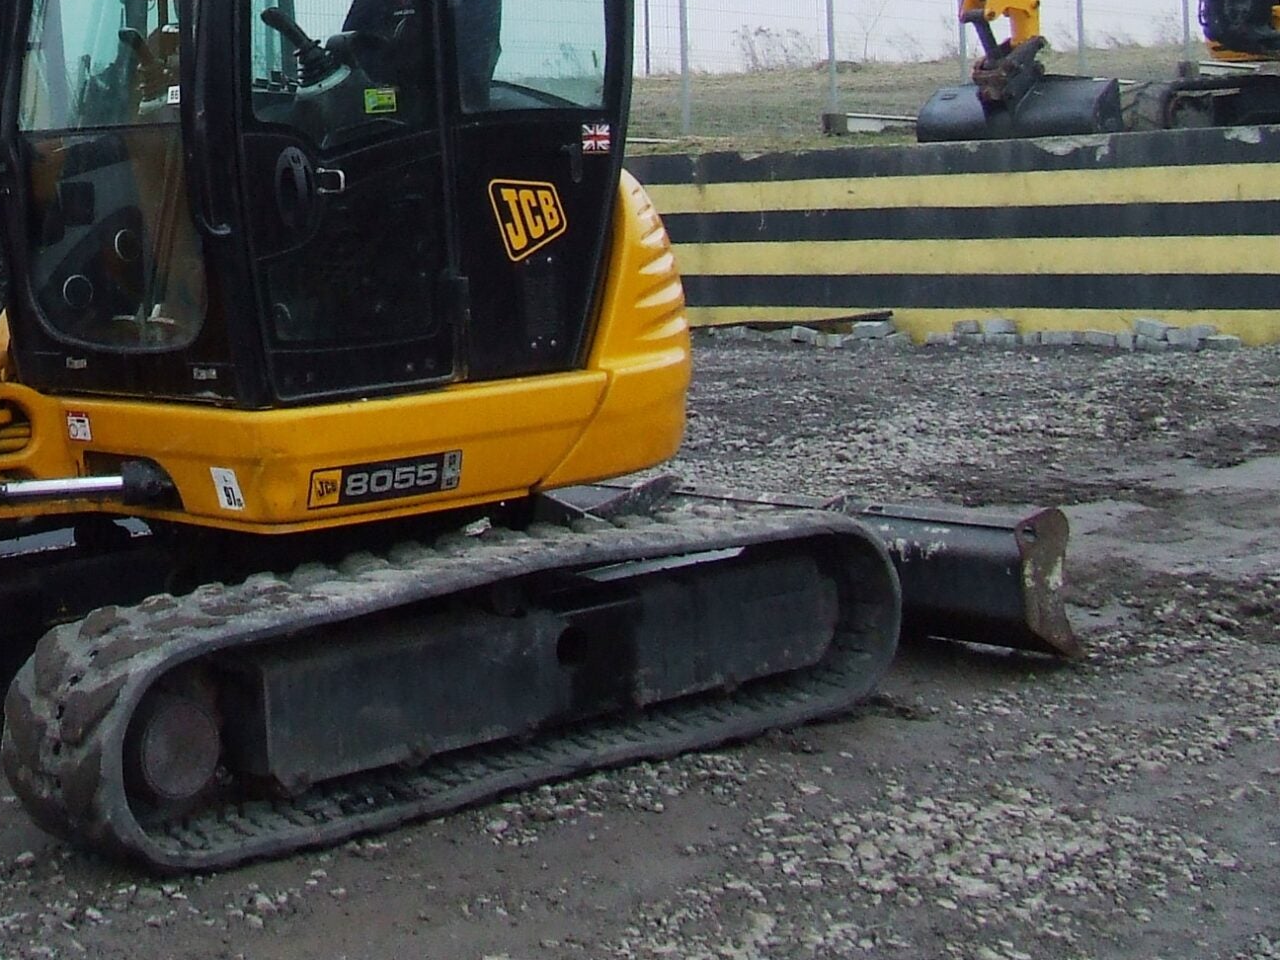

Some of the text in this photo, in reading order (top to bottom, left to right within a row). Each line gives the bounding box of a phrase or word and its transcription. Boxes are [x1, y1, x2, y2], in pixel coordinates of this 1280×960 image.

[500, 188, 560, 251] JCB
[317, 478, 338, 497] JCB
[345, 462, 438, 496] 8055
